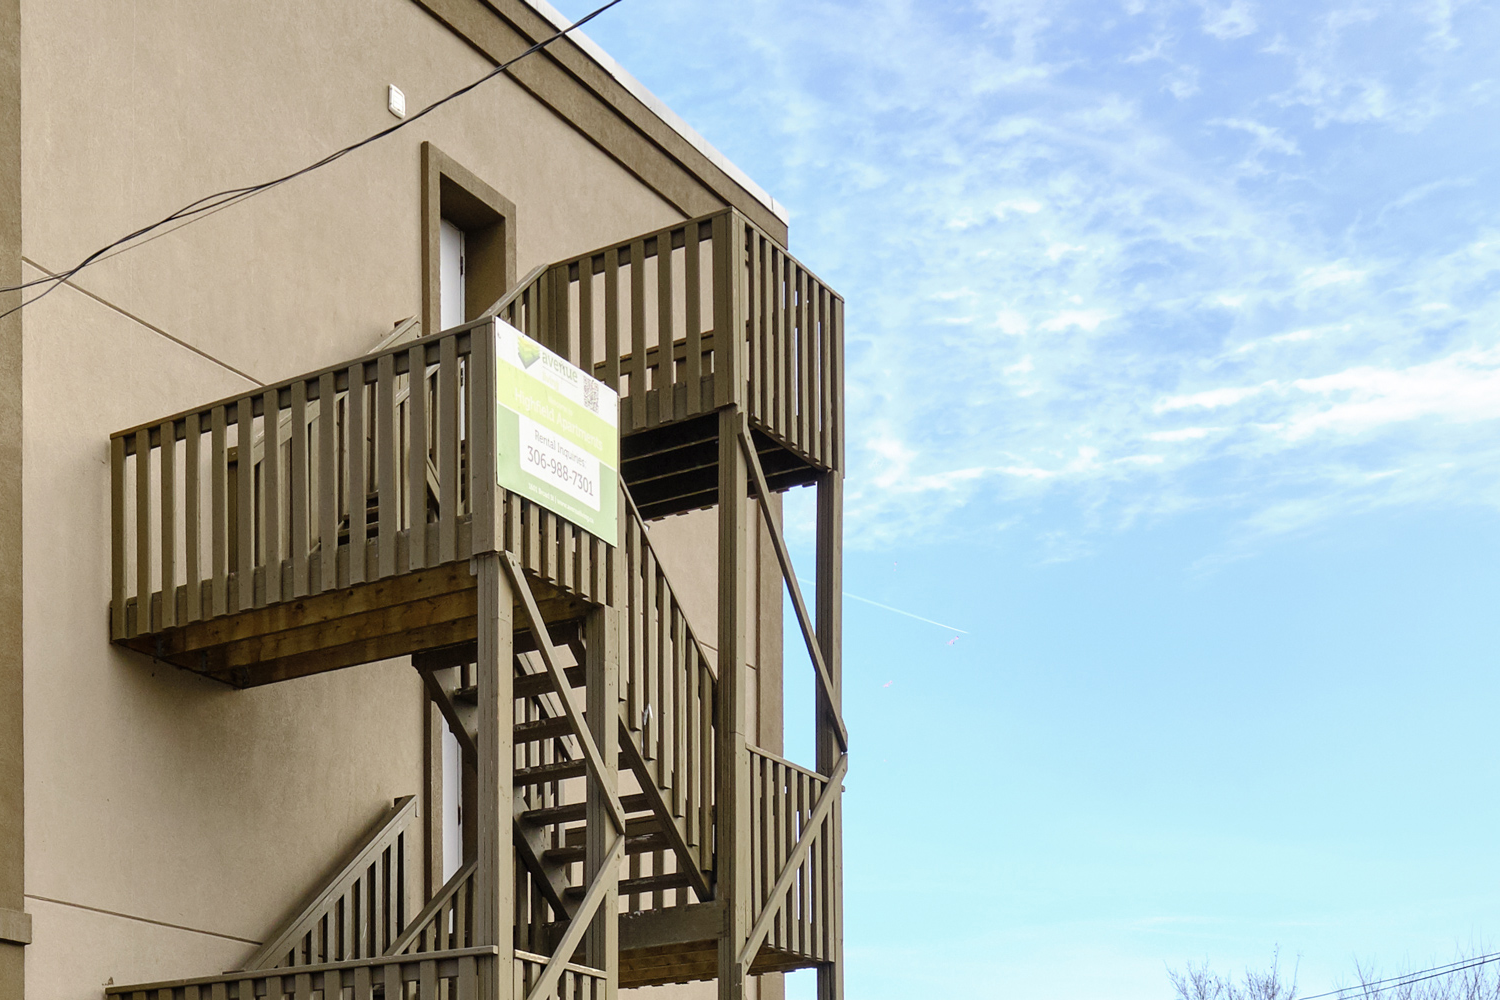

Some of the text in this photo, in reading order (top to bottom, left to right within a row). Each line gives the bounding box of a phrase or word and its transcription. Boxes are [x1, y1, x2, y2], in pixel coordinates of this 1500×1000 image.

[541, 351, 579, 383] avenue
[515, 387, 603, 451] Highfield Apartments
[534, 429, 557, 452] Rental
[527, 445, 594, 497] 306-988-7301
